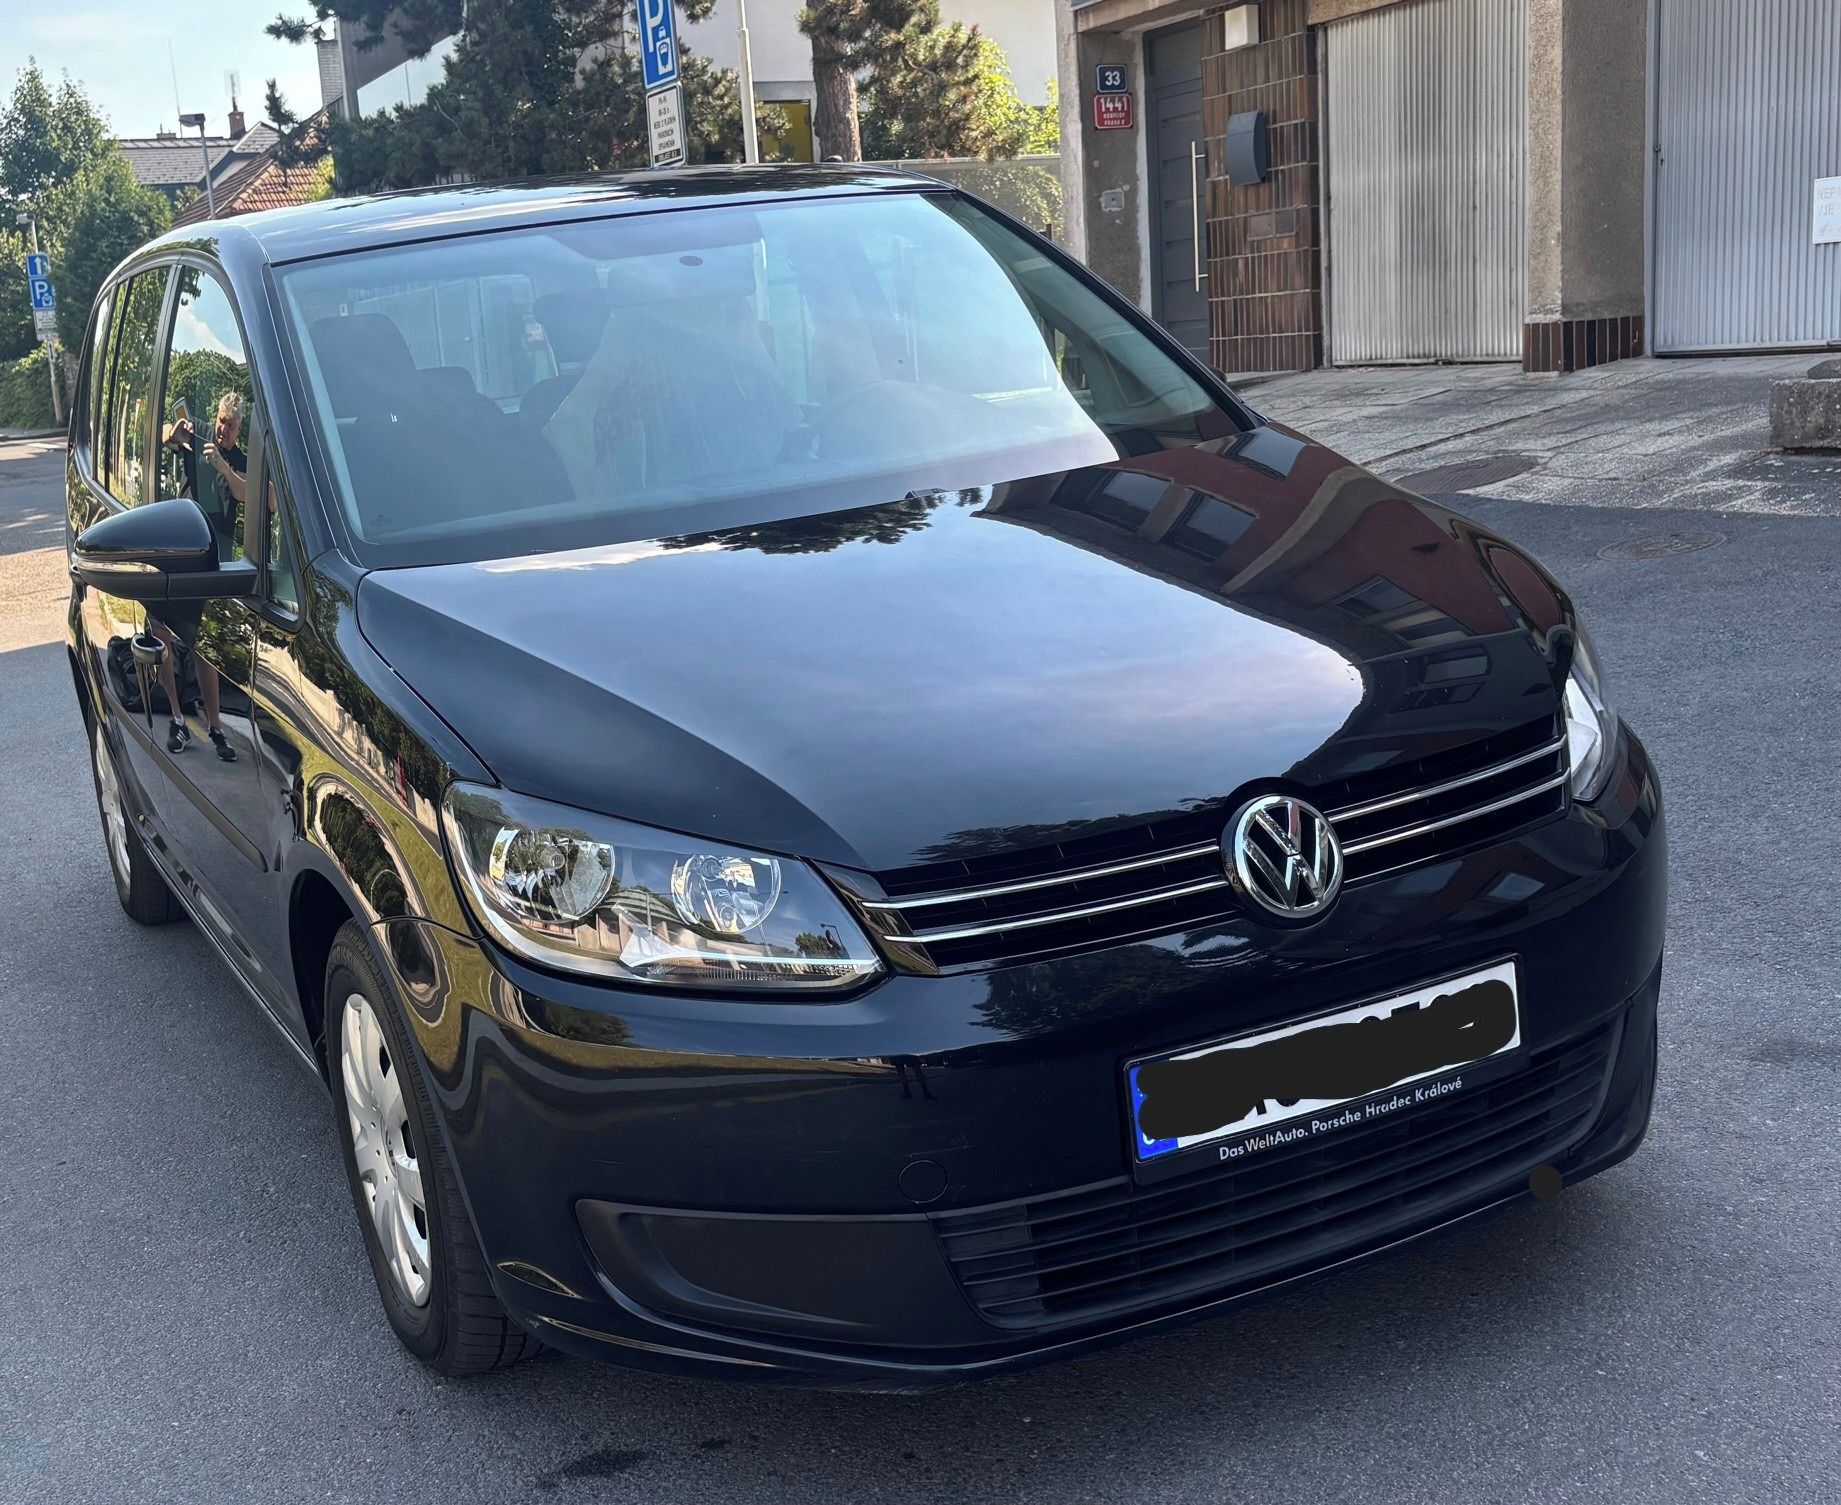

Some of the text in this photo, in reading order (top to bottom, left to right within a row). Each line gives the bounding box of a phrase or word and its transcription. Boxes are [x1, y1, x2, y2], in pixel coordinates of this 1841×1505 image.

[643, 0, 664, 53] P
[1105, 71, 1121, 86] 33
[1100, 97, 1128, 112] 1441
[34, 281, 49, 300] P
[1219, 1076, 1462, 1160] Das WeltAuto. Porsche Hradec Králové
